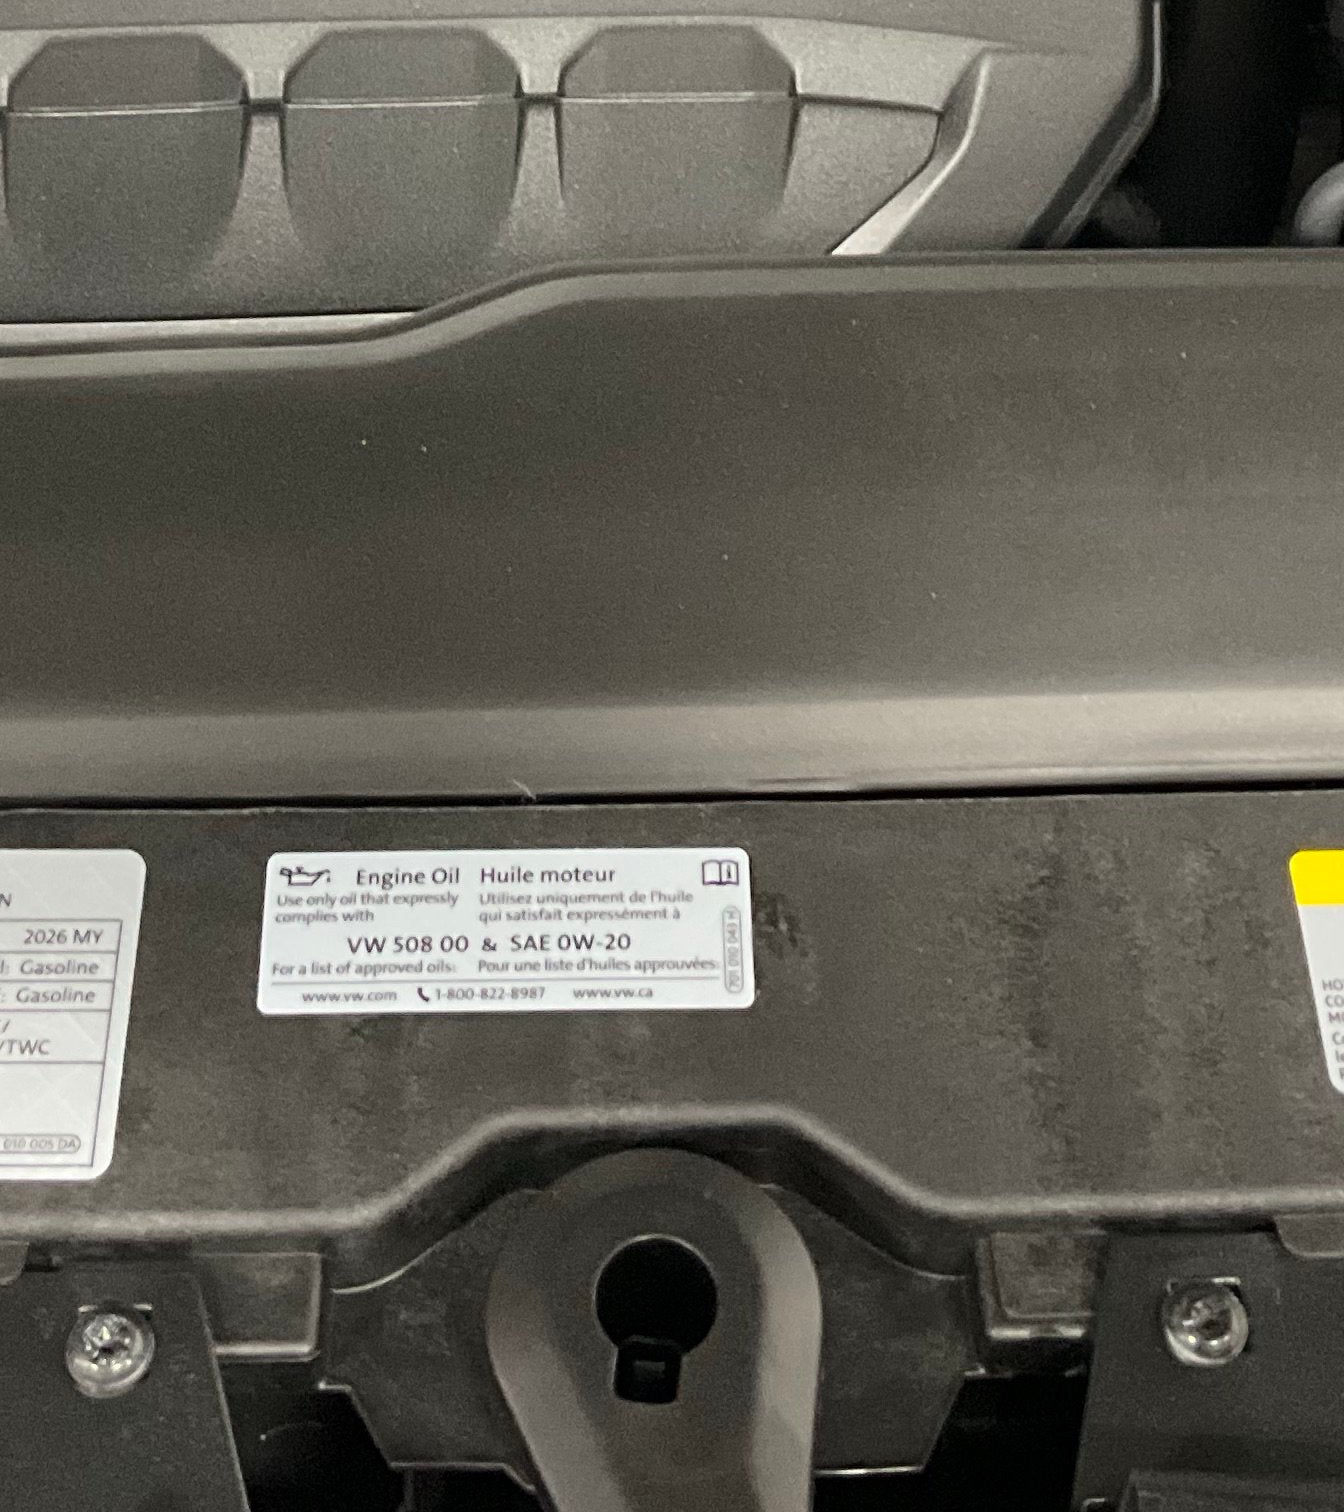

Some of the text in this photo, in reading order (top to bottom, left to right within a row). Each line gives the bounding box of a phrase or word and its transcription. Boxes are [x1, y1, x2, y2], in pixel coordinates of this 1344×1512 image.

[357, 867, 460, 890] Engine Oil
[480, 867, 616, 883] Huile moteur
[277, 891, 459, 908] Use only oil that expressly
[480, 891, 694, 906] Utilisez uniquement de l'huile
[275, 910, 374, 925] complies with
[479, 907, 680, 923] qui satisfait expressément à
[24, 929, 104, 945] 2026 MY
[348, 936, 469, 953] VW 508 00
[482, 938, 497, 951] &
[511, 934, 631, 951] SAE 0W-20
[20, 959, 99, 975] Gasoline
[272, 963, 295, 975] For
[298, 965, 306, 975] a
[311, 962, 331, 974] list
[336, 961, 351, 974] of
[355, 960, 422, 976] approved
[479, 960, 510, 972] Pour
[515, 961, 541, 971] une
[545, 958, 573, 971] liste
[16, 988, 96, 1004] Gasoline
[302, 990, 397, 1002] www.vw.com
[435, 986, 545, 1000] 1-800-822-8987
[573, 987, 653, 998] www.vw.ca
